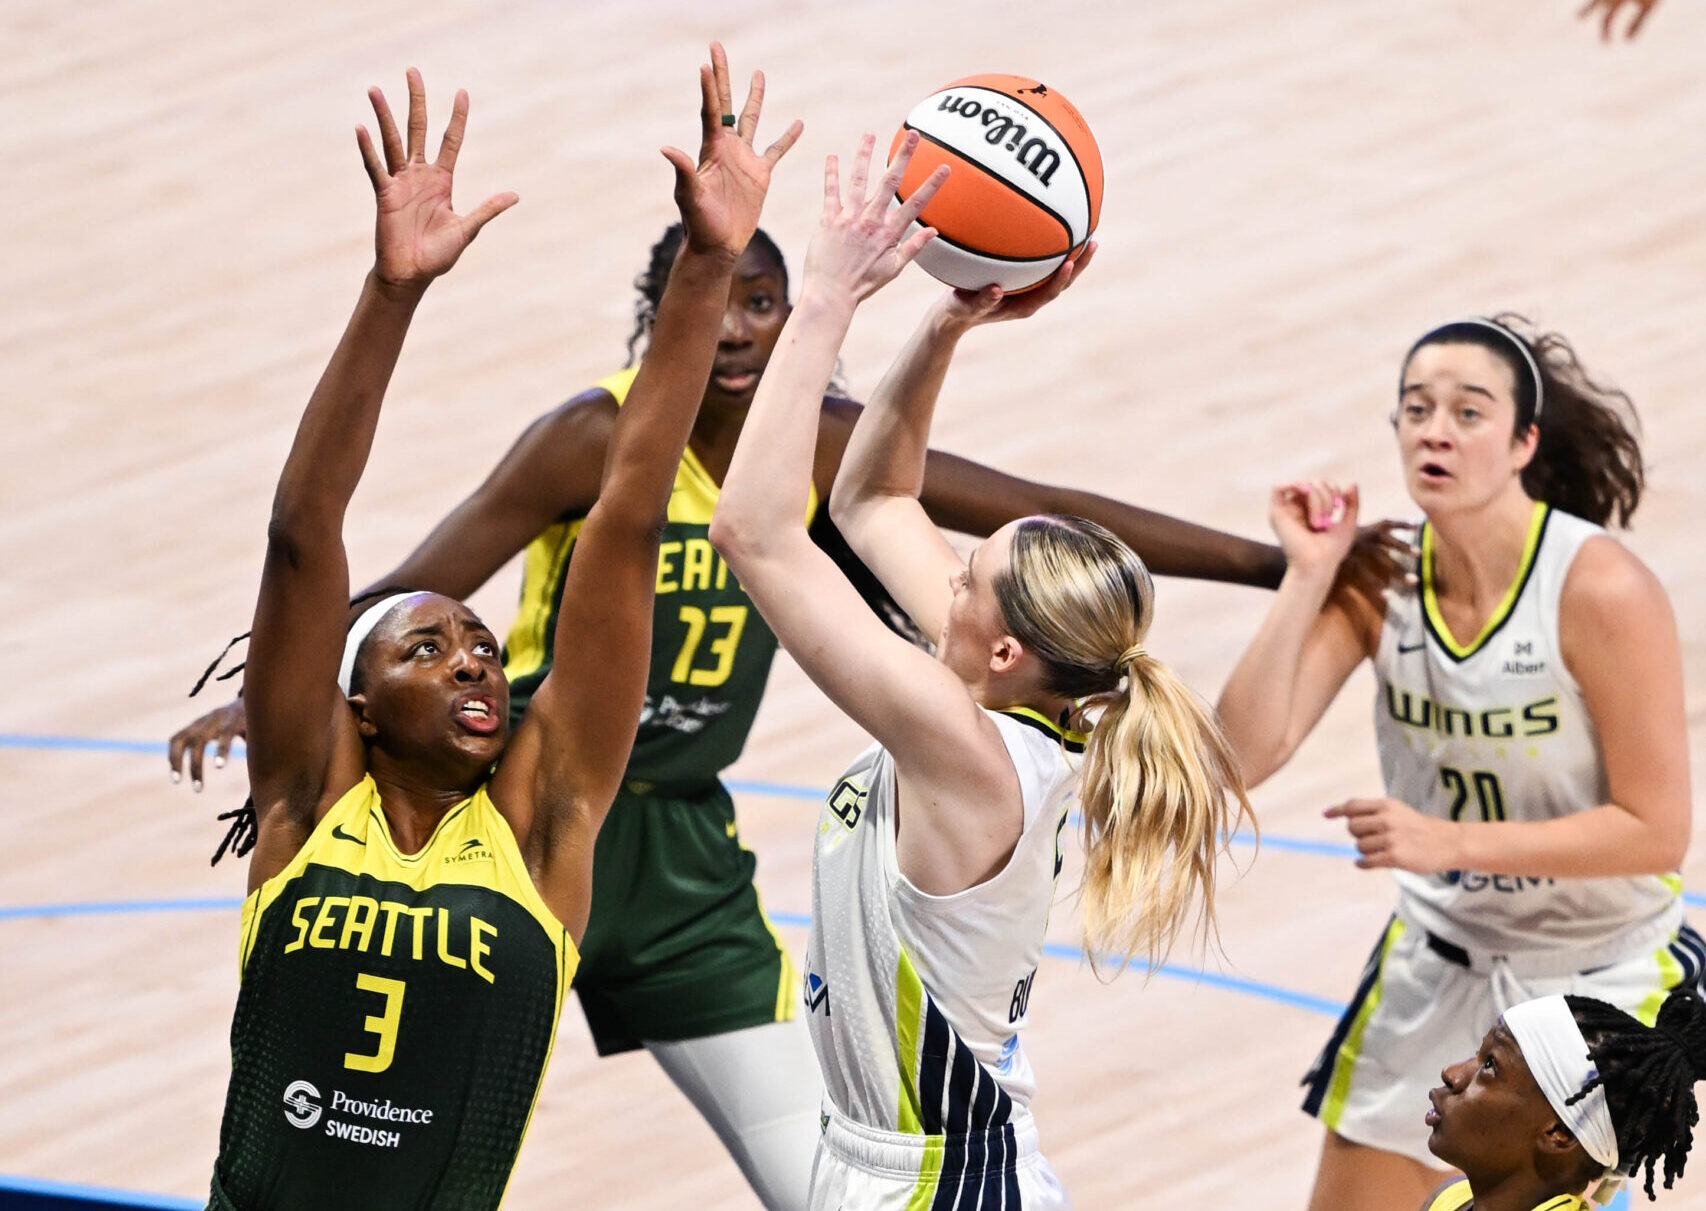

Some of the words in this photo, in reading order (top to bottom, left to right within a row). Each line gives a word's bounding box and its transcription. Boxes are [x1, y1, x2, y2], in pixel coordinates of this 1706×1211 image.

[937, 94, 1061, 189] Wilson
[670, 605, 748, 687] 13
[1502, 660, 1546, 676] Albert
[1385, 683, 1560, 738] WINGS
[1440, 766, 1506, 822] 20
[444, 850, 494, 864] SYMETRA
[284, 895, 499, 985] SEATTLE
[343, 972, 406, 1074] 3
[325, 1119, 401, 1148] SWEDISH
[330, 1090, 433, 1125] Providence
